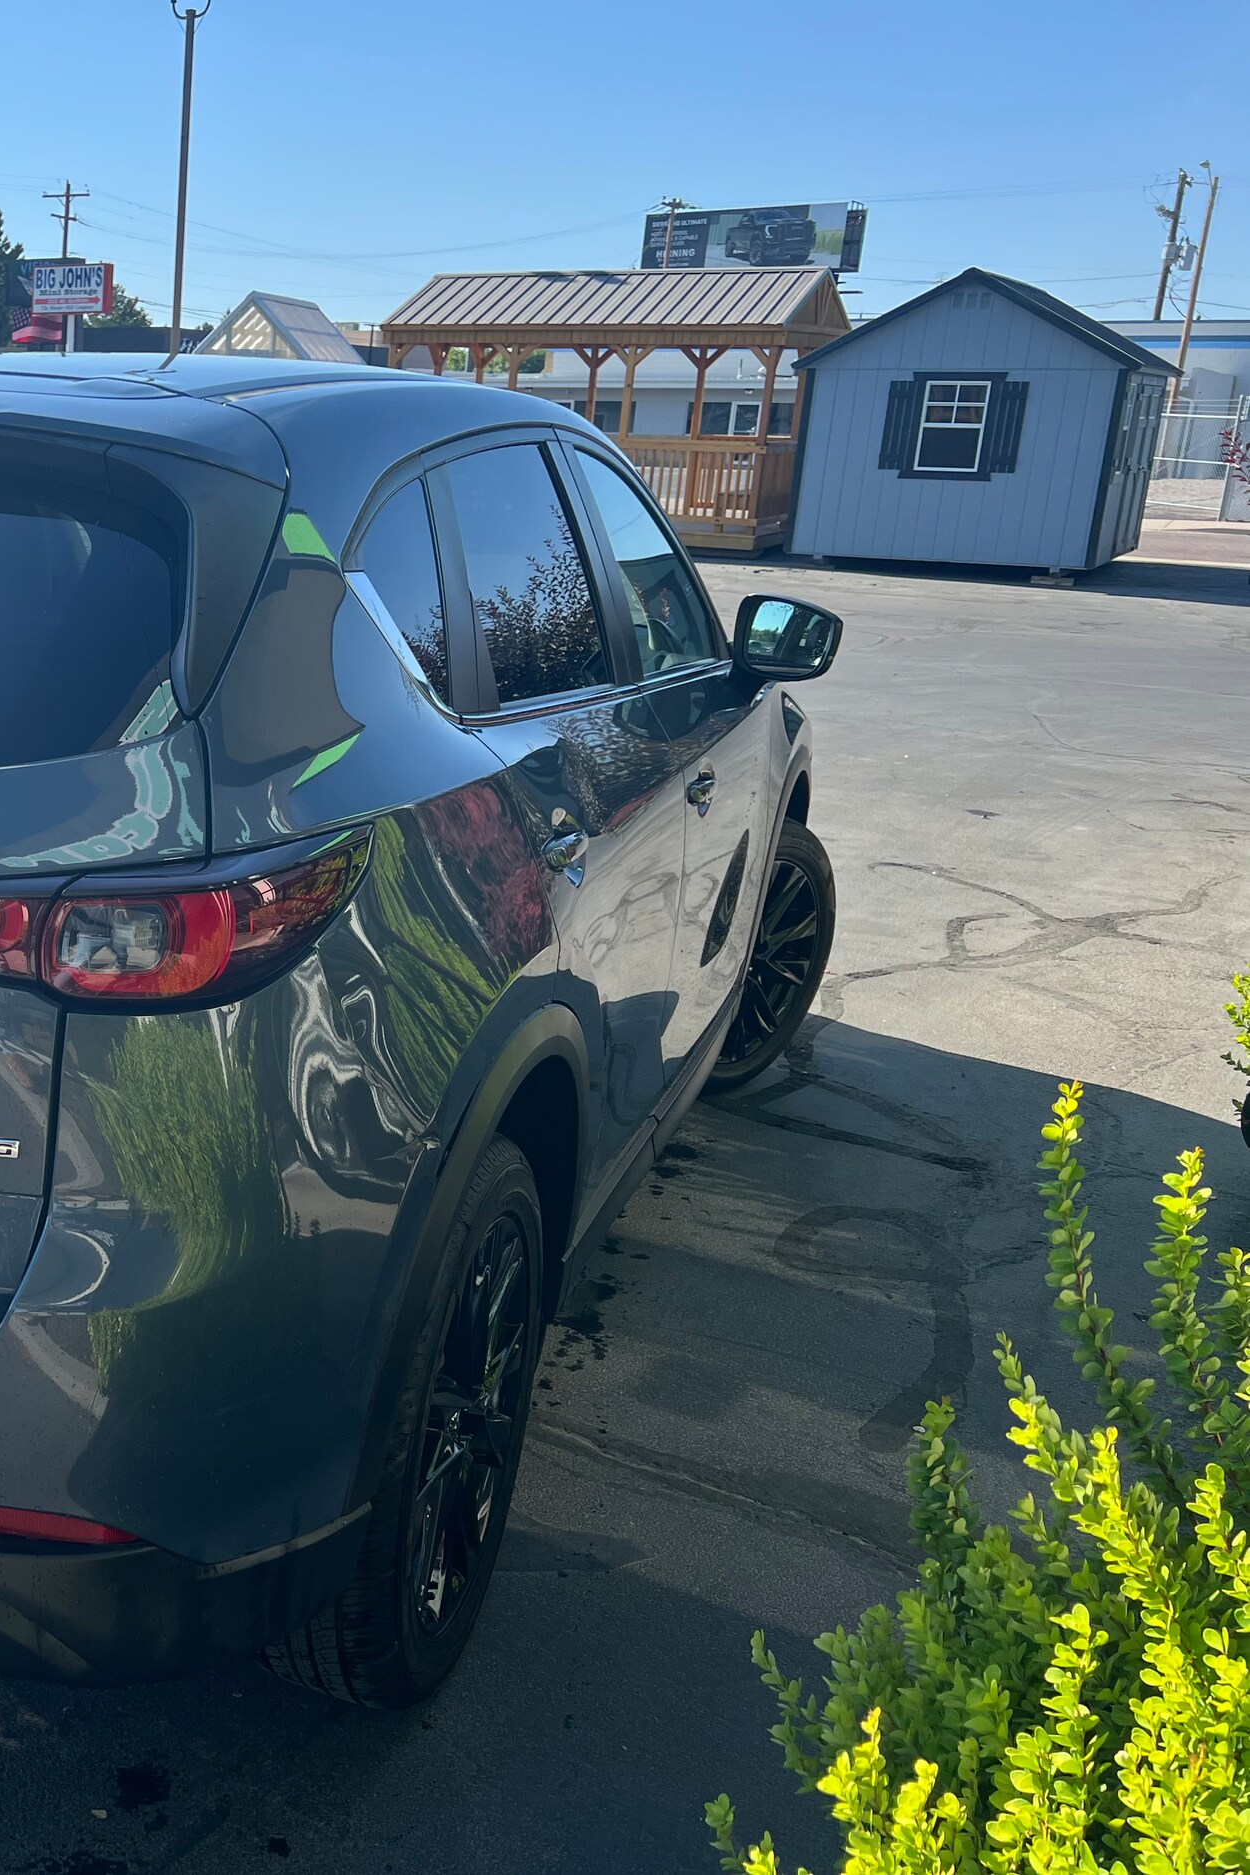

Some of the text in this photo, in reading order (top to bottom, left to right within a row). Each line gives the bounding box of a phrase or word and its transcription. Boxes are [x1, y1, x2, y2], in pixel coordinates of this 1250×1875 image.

[656, 249, 696, 257] HNING
[36, 267, 103, 289] BIG JOHN'S
[63, 288, 98, 296] Storage
